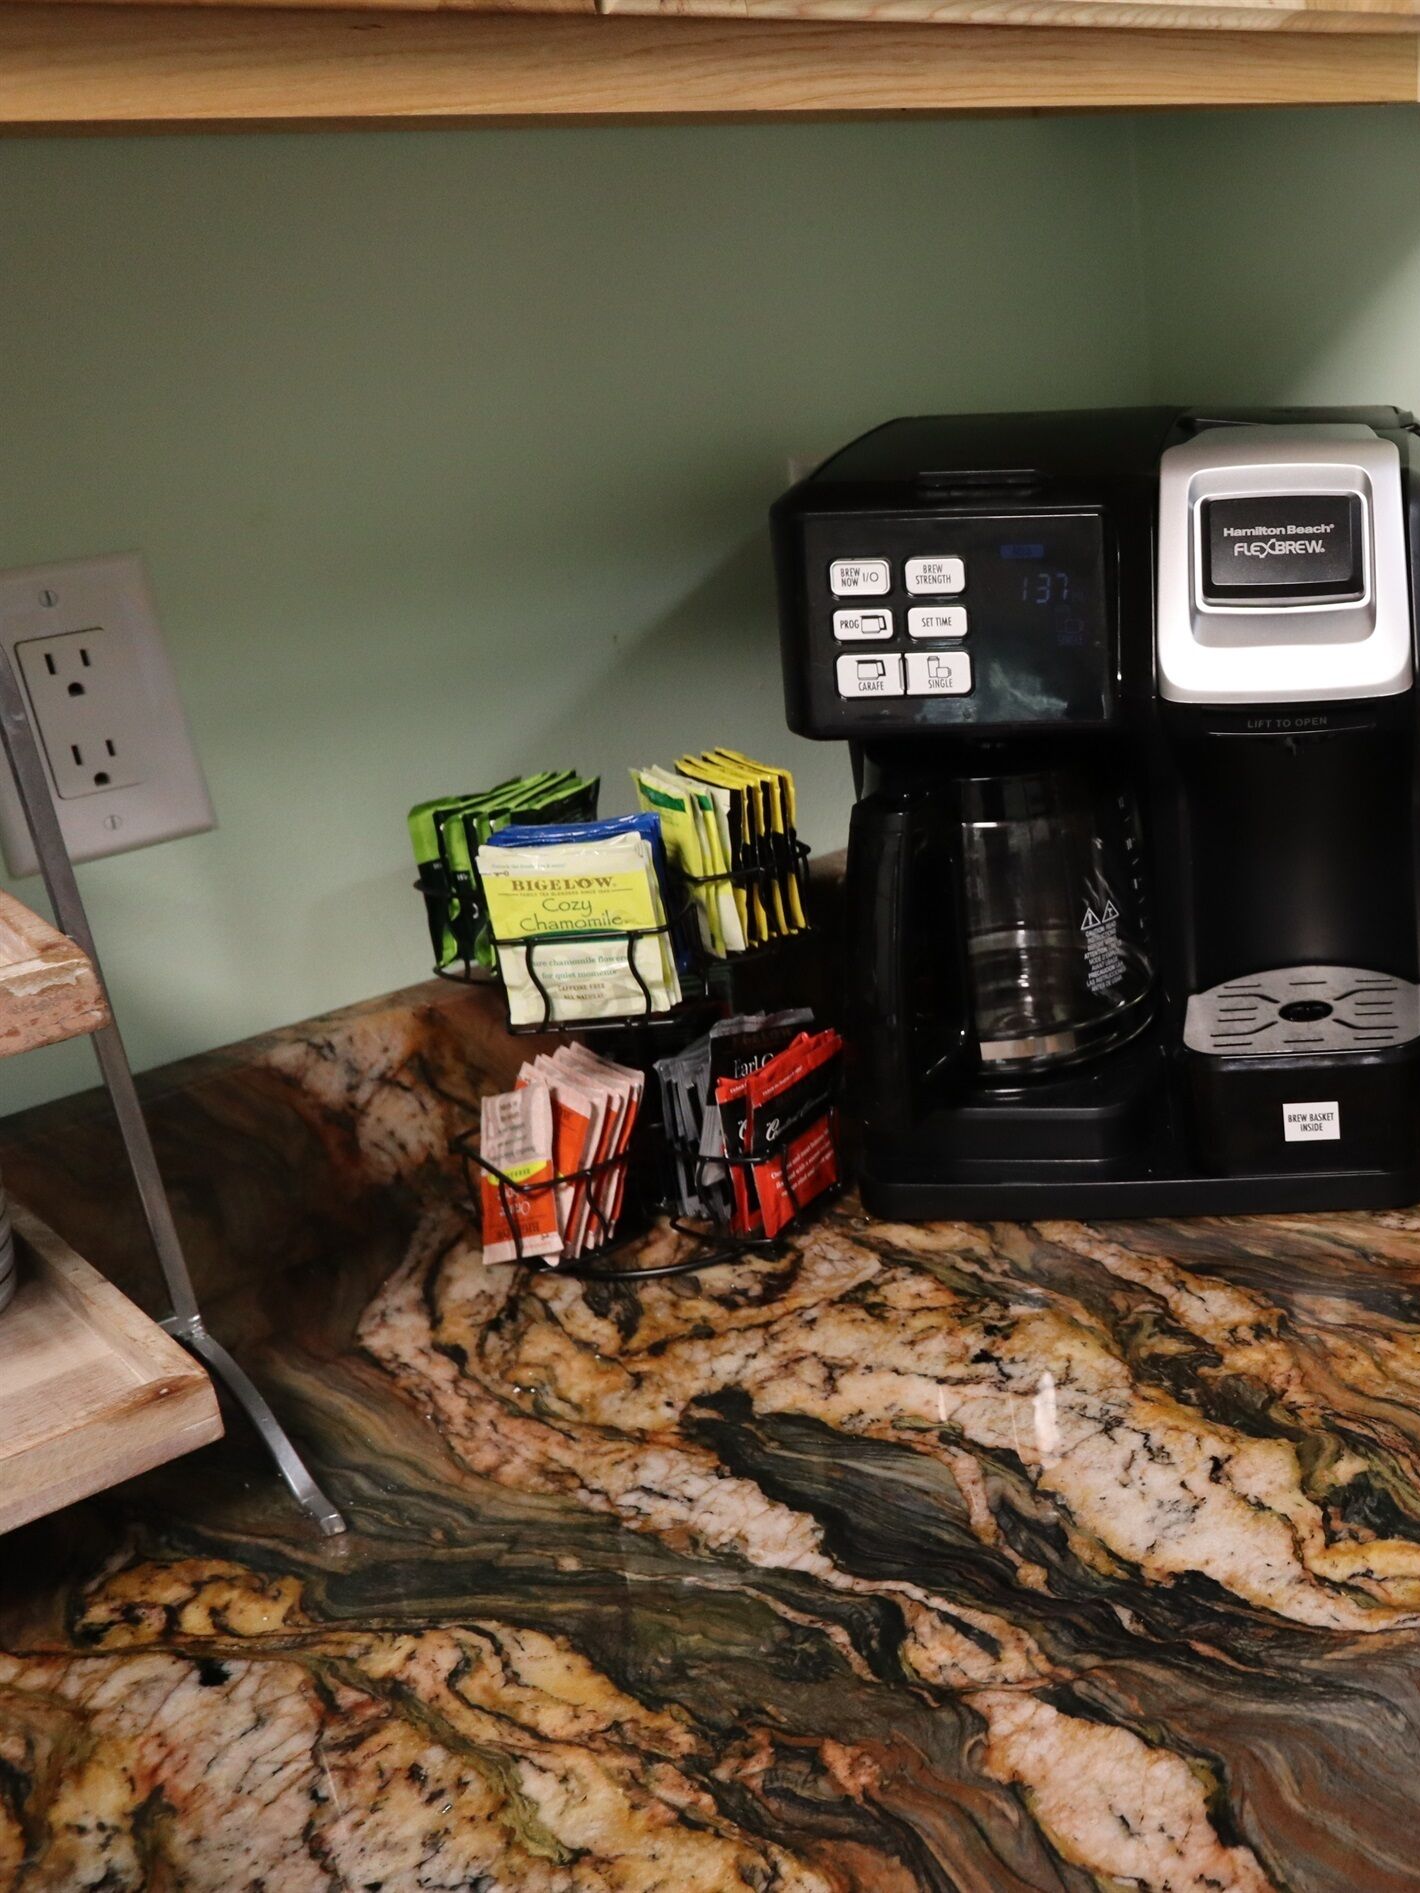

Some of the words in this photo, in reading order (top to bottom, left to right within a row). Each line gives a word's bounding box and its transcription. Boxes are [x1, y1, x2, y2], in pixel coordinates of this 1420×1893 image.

[1223, 526, 1285, 537] Hamilton
[840, 567, 861, 578] BREW
[922, 564, 943, 574] BREW
[841, 577, 859, 587] NOW
[915, 574, 952, 585] STRENGTH
[839, 619, 860, 629] PROG
[921, 618, 934, 628] SET
[935, 616, 952, 627] TIME
[858, 681, 885, 692] CARAFE
[927, 678, 953, 689] SINGLE
[1247, 719, 1272, 729] LIFT
[1276, 719, 1291, 728] TO
[1295, 716, 1327, 727] OPEN
[512, 877, 613, 891] BIGELOW
[542, 898, 592, 917] Cozy
[520, 910, 623, 932] Chamomile
[548, 956, 597, 967] chamomile
[1288, 1114, 1307, 1122] BREW
[1309, 1112, 1334, 1121] BASKET
[1300, 1123, 1323, 1132] INSIDE
